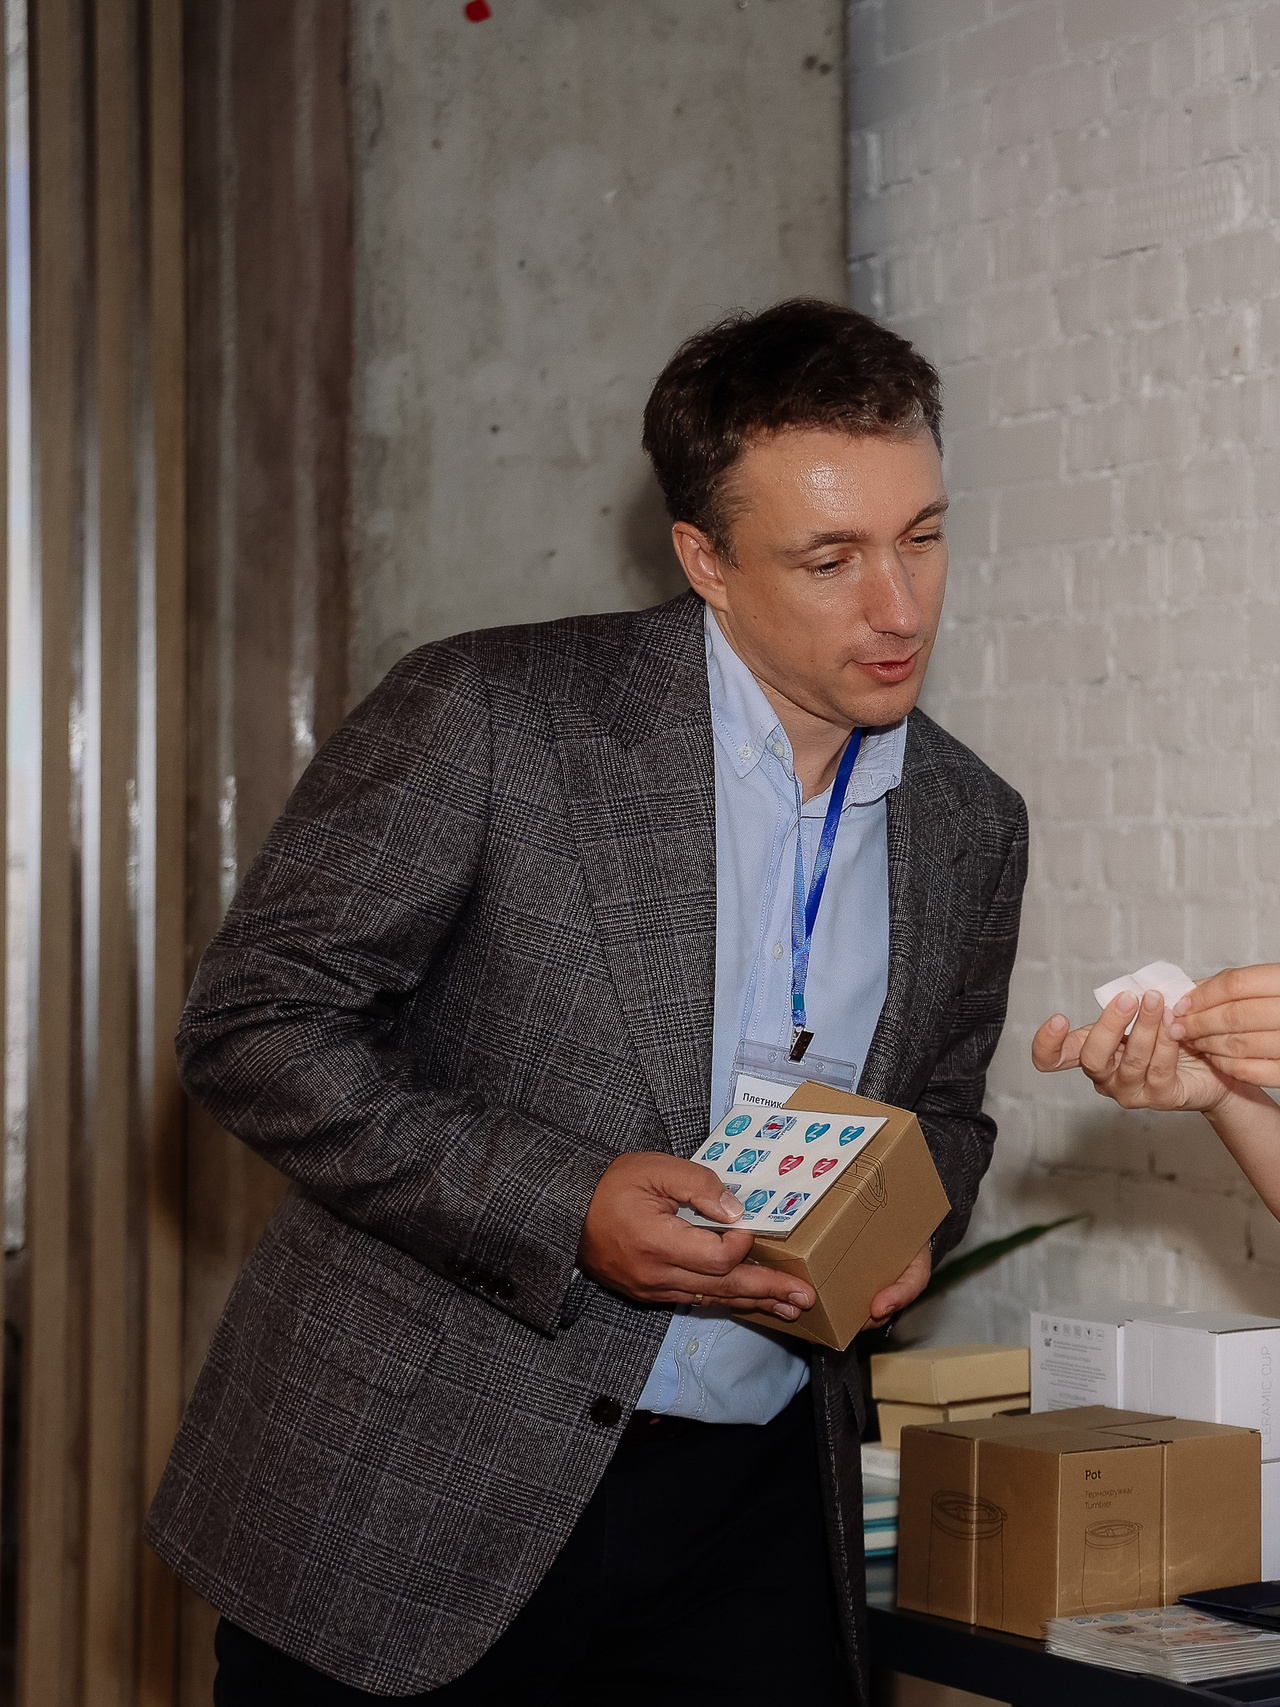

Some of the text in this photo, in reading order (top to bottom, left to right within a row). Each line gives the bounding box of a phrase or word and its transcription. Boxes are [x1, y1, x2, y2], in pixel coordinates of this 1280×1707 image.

[742, 1092, 786, 1109] Плетник
[1261, 1346, 1272, 1445] CERAMIC CUP
[1085, 1469, 1102, 1481] Pot
